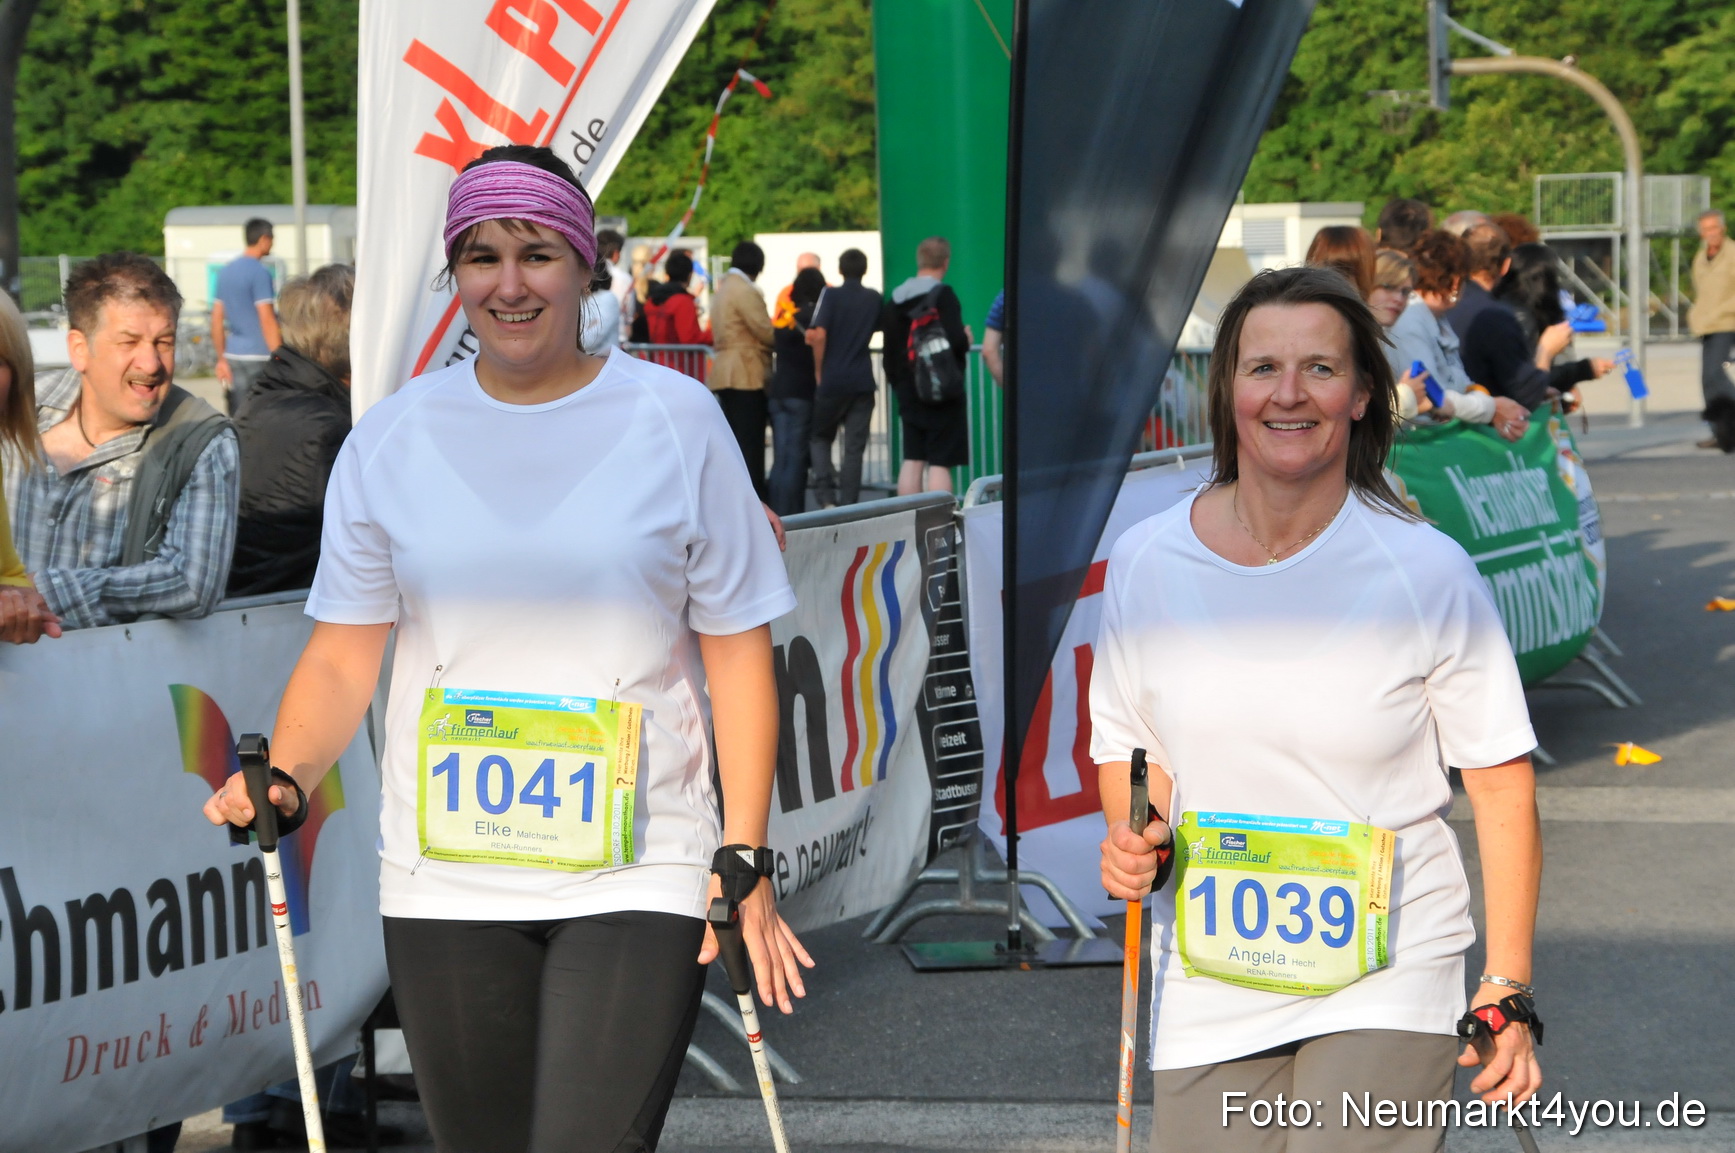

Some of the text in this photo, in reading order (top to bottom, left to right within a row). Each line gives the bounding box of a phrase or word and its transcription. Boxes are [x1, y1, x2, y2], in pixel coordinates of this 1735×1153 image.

[451, 723, 519, 740] firmenlauf
[432, 752, 595, 823] 1041
[475, 820, 559, 842] Elke Malcharek
[490, 842, 543, 853] RENA-Runners
[1206, 847, 1272, 863] firmenlauf
[1189, 875, 1355, 949] 1039
[0, 855, 268, 1013] hmann
[1228, 946, 1316, 968] Angela Hecht
[1246, 968, 1298, 980] RENA-Runners
[62, 1012, 172, 1083] Druck
[189, 1004, 208, 1049] &
[223, 978, 324, 1038] Medn
